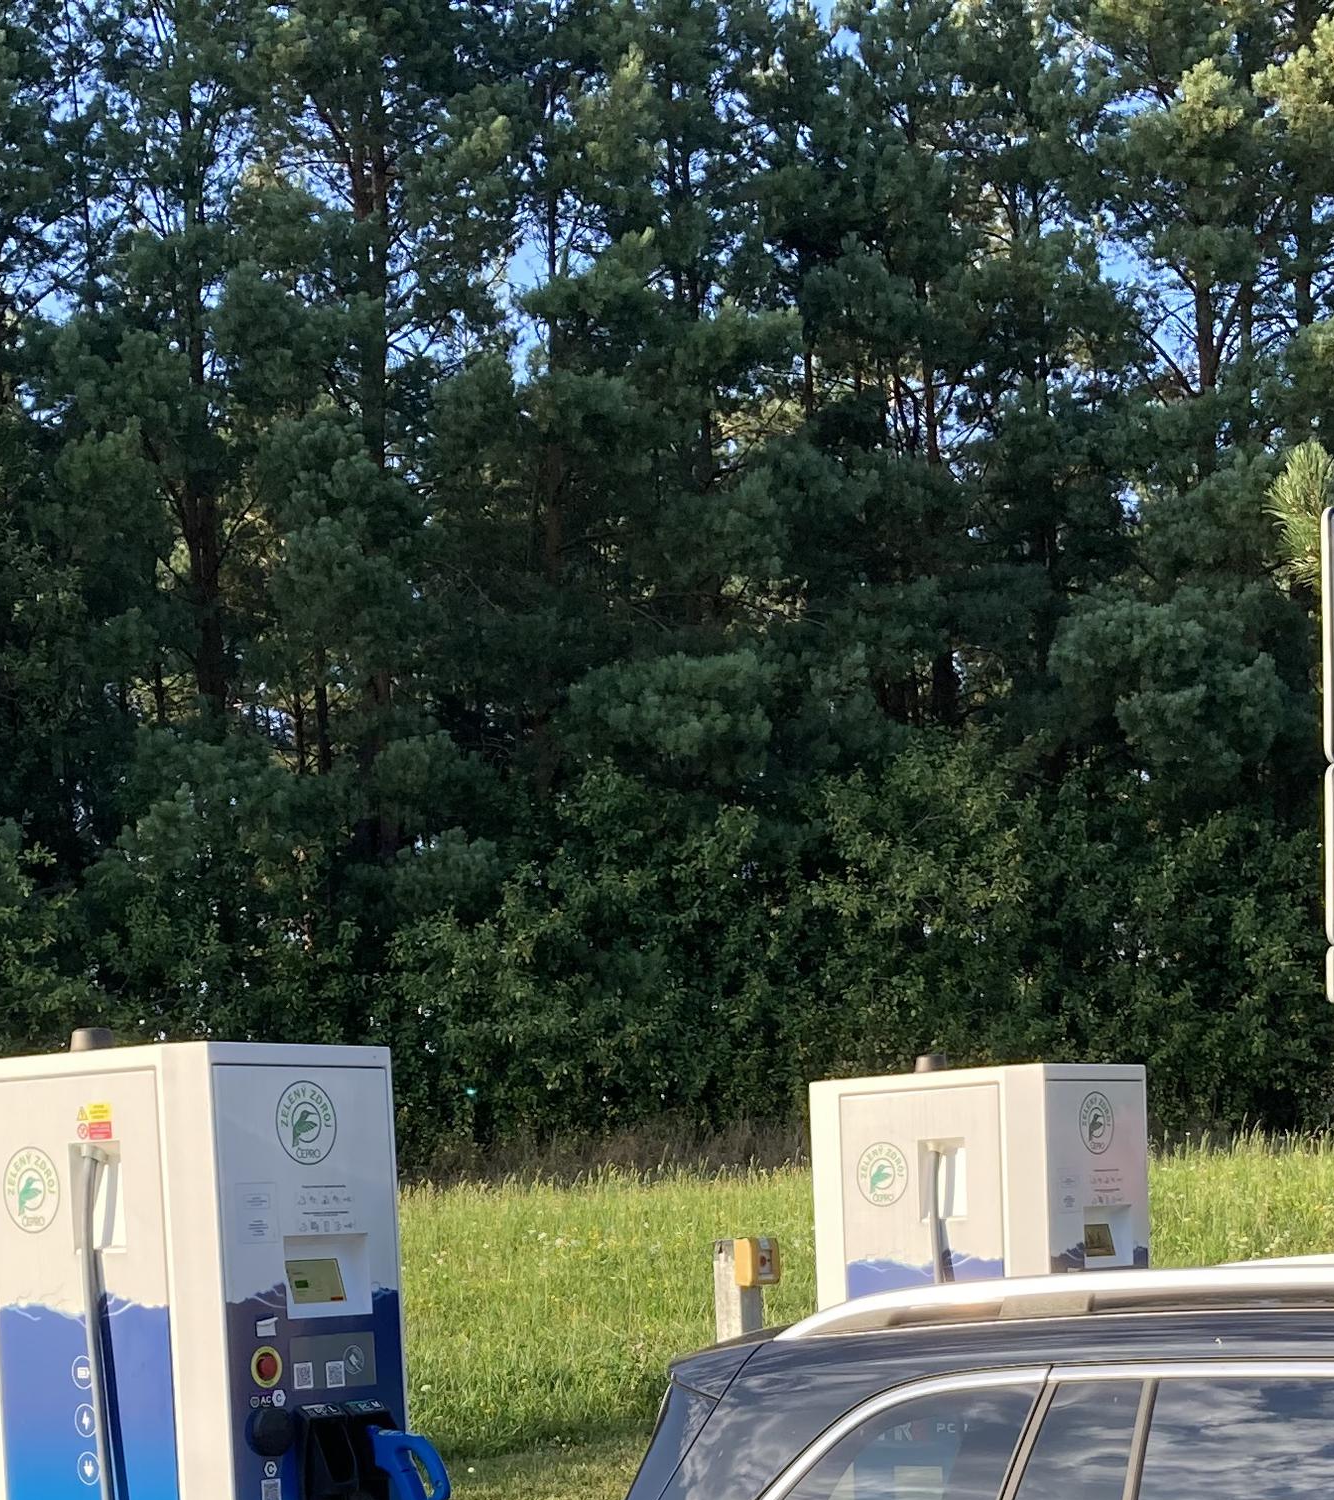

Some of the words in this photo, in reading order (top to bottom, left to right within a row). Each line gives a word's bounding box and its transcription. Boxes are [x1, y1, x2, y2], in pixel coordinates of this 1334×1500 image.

[280, 1084, 307, 1128] ZELENÝ
[310, 1088, 332, 1128] ZDROJ
[33, 1155, 57, 1195] ZDROJ
